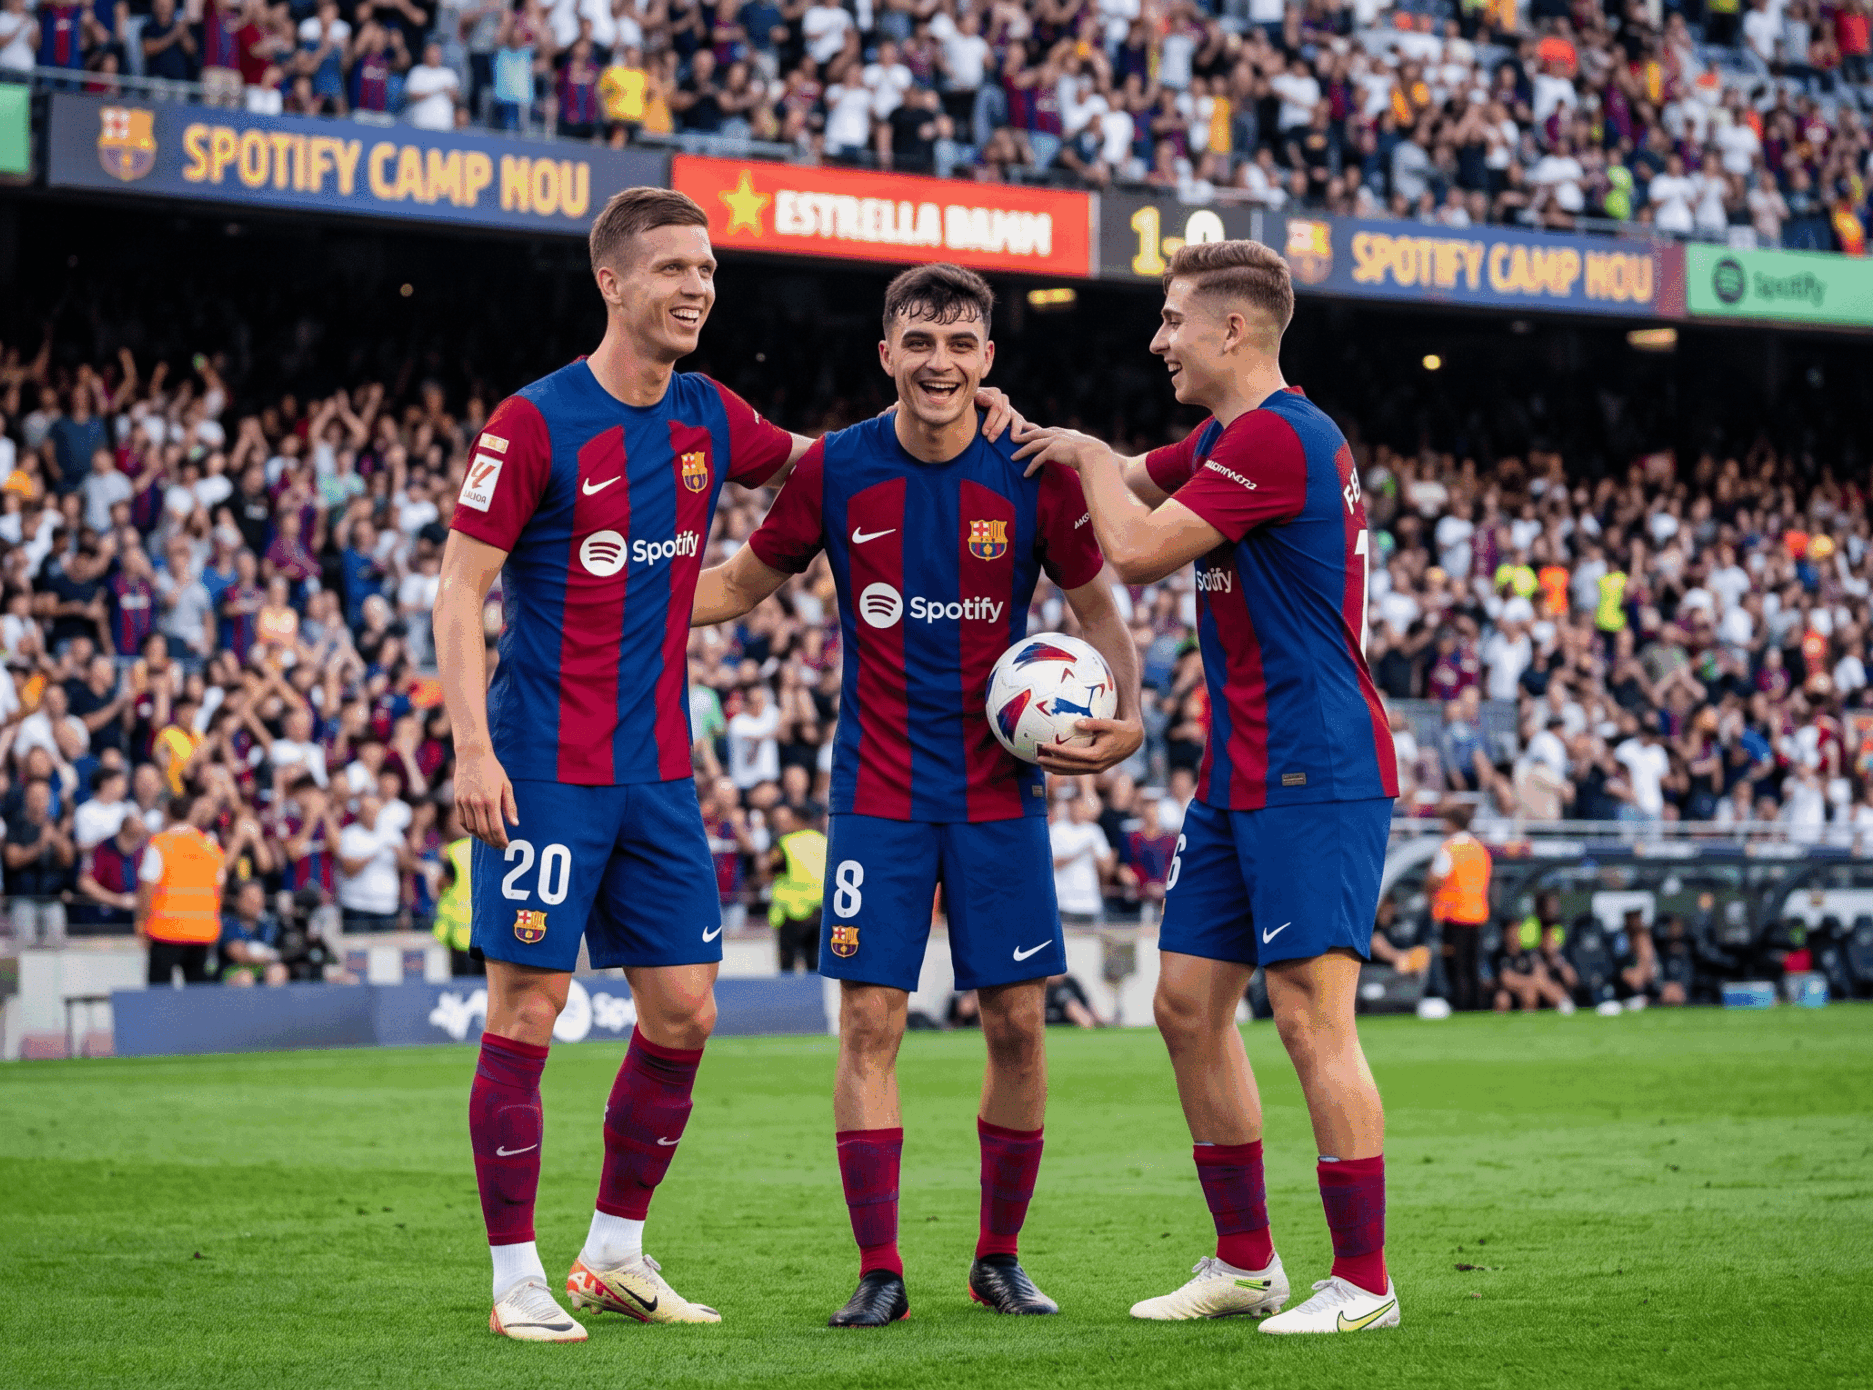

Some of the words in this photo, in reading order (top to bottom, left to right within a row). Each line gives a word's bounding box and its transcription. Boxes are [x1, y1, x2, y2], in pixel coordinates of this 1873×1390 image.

[182, 123, 361, 196] SPOTIFY
[367, 141, 493, 209] CAMP
[500, 154, 591, 219] NOU
[775, 189, 943, 248] ESTRELLA
[1351, 231, 1486, 291] SPOTIFY
[1488, 241, 1582, 299] CAMP
[1584, 251, 1655, 304] NOU
[632, 530, 700, 566] Spotify
[909, 596, 1004, 624] Spotify
[501, 839, 572, 906] 20
[833, 859, 865, 919] 8
